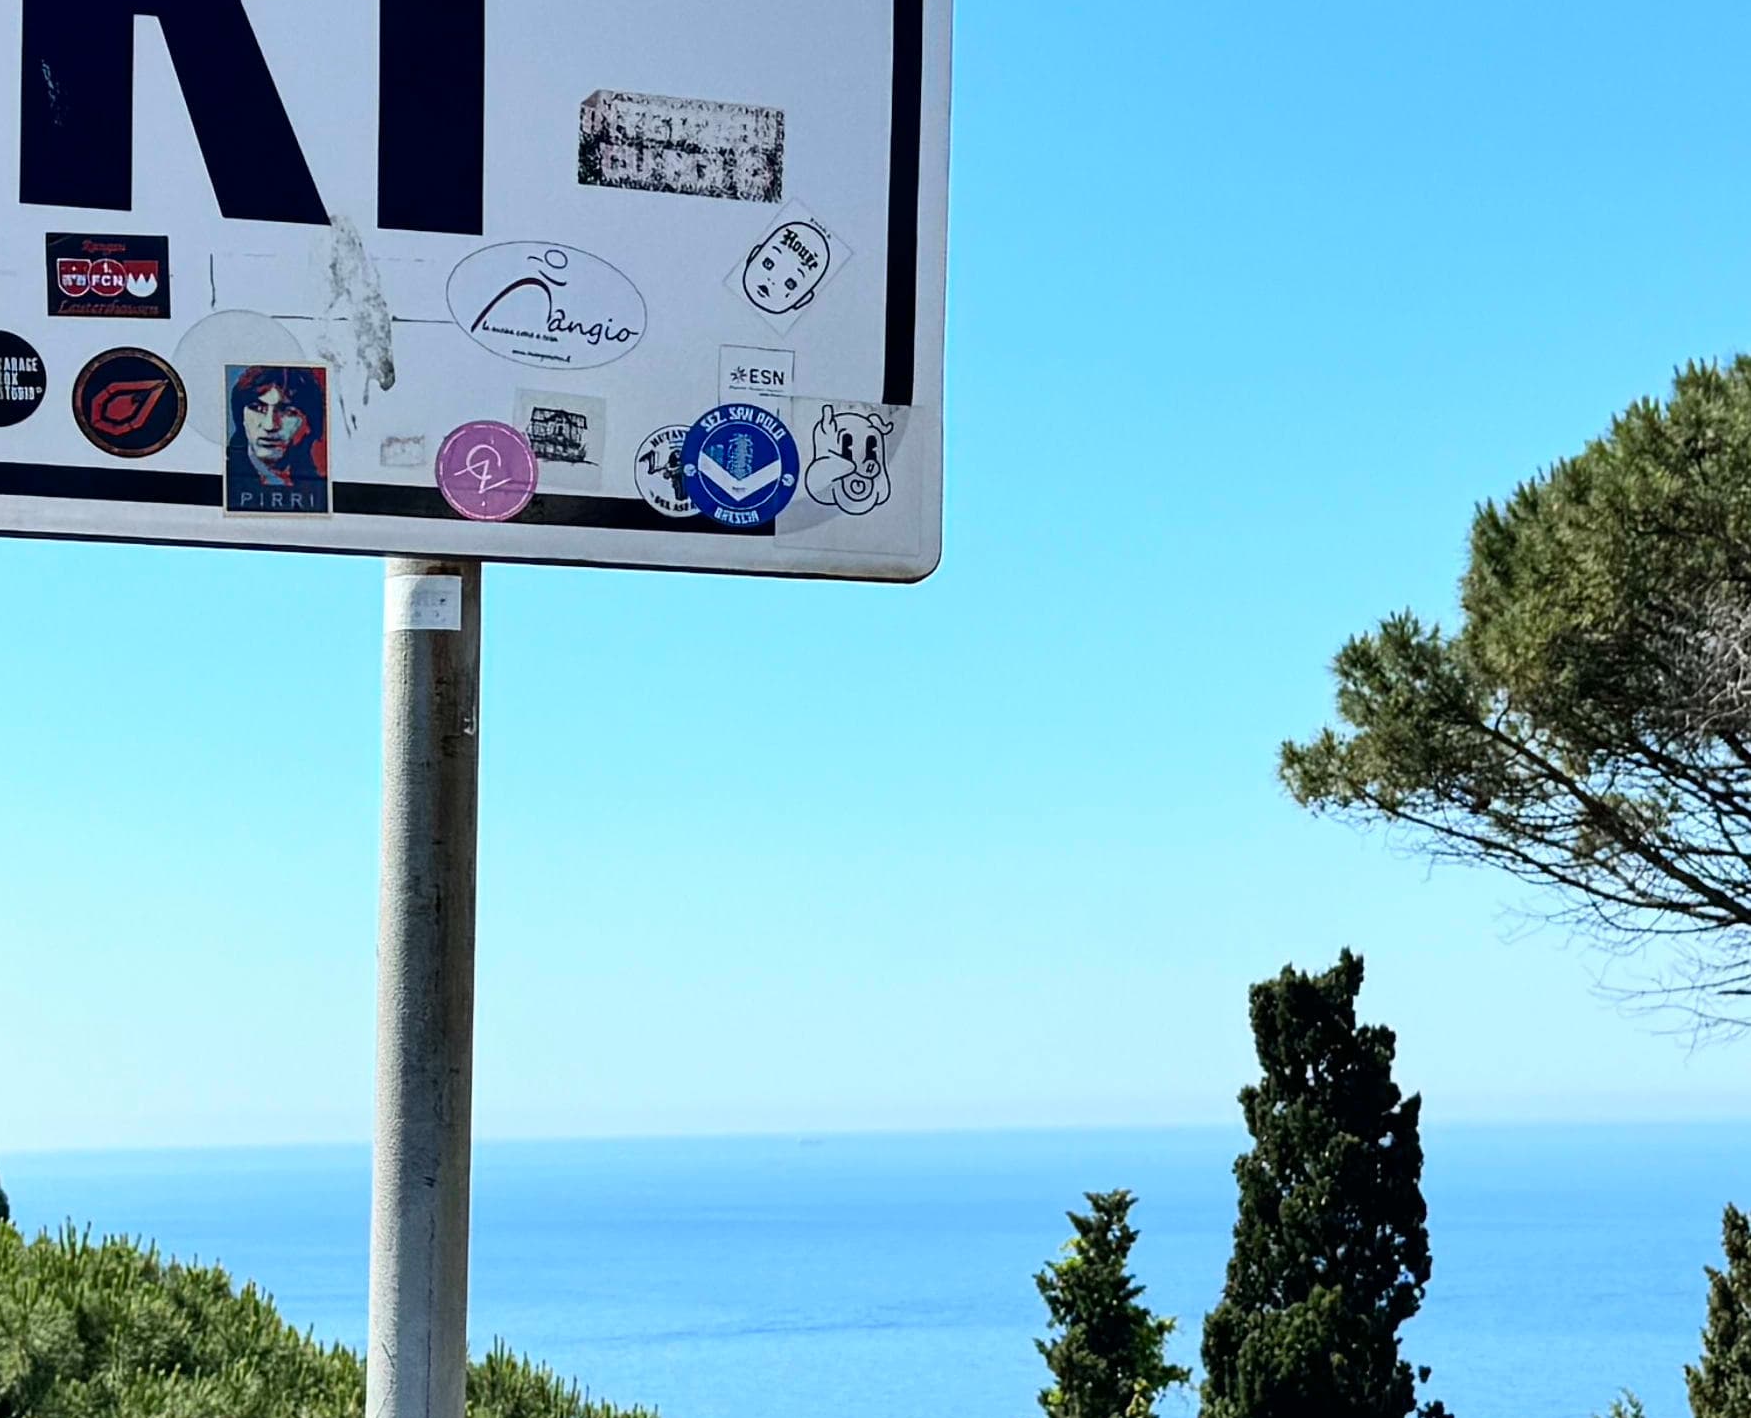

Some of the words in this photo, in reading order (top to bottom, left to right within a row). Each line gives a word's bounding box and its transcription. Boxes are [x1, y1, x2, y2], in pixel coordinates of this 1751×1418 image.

[92, 275, 124, 287] FCN
[750, 368, 784, 386] ESN
[240, 491, 314, 508] PIRRI
